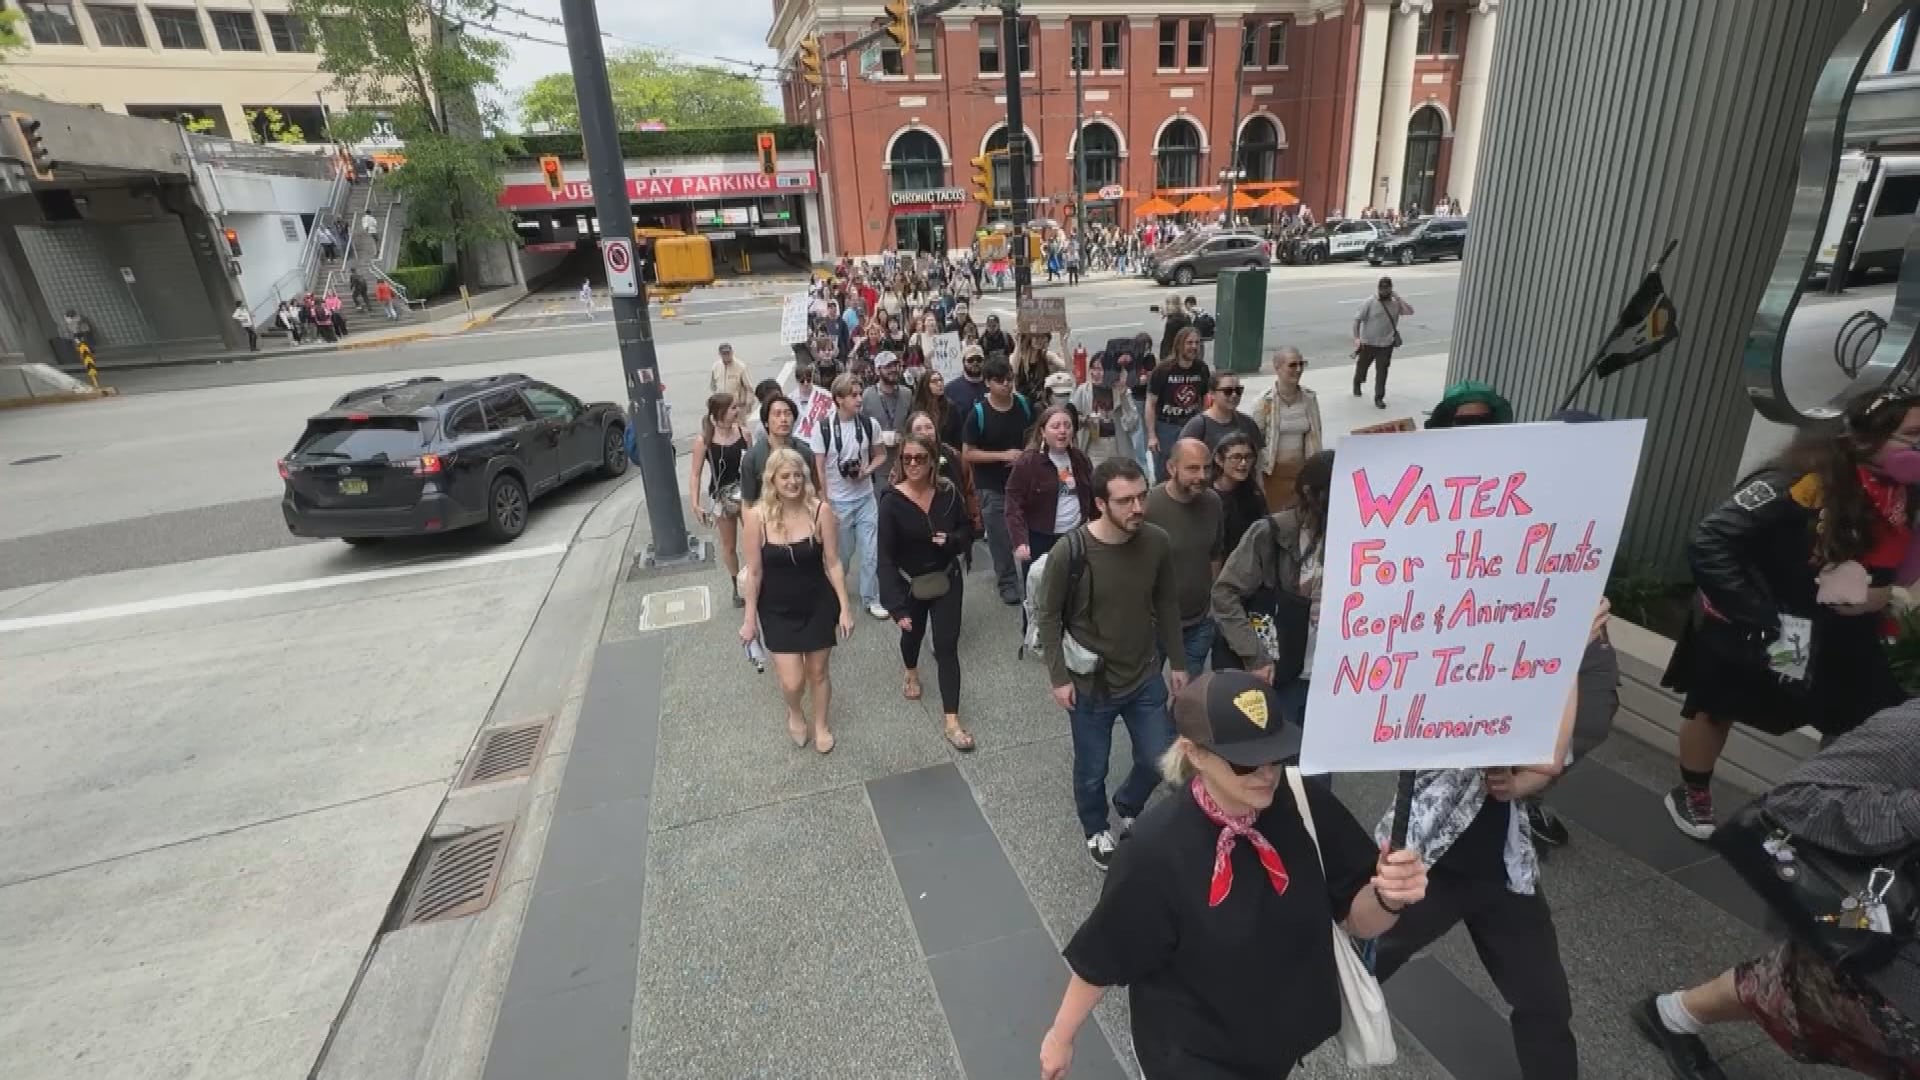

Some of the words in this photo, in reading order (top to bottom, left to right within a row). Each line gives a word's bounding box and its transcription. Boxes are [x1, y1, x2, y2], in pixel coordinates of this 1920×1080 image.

[552, 184, 594, 201] PUB
[635, 178, 673, 195] PAY
[682, 174, 770, 194] PARKING
[891, 190, 934, 206] CHRONIC
[934, 188, 965, 202] TACOS
[1352, 465, 1533, 528] WATER
[1350, 539, 1425, 586] For
[1446, 529, 1503, 580] the
[1516, 520, 1603, 575] Plants
[1341, 590, 1425, 653] People
[1447, 578, 1557, 629] Animals
[1333, 651, 1418, 695] NOT
[1432, 641, 1562, 687] Tech-bro
[1373, 694, 1513, 743] billionaires
